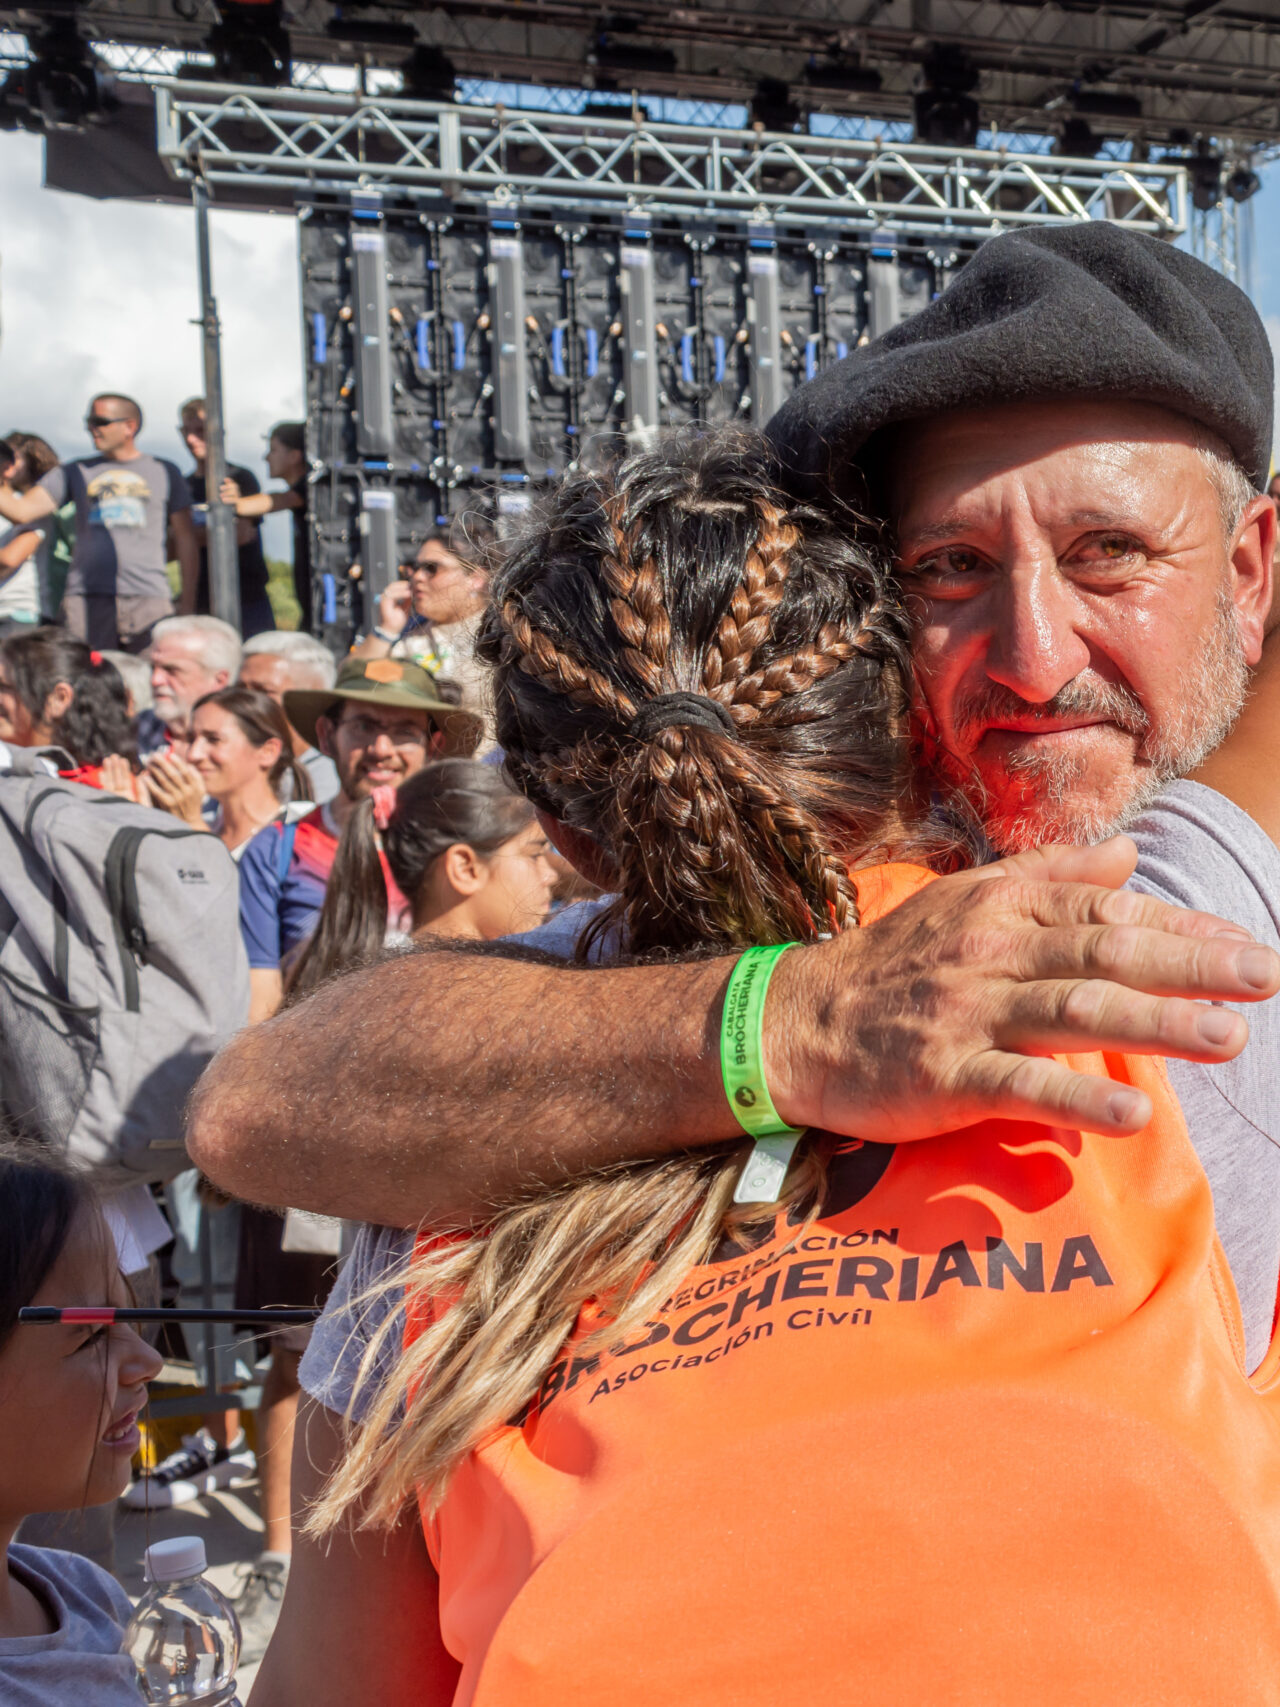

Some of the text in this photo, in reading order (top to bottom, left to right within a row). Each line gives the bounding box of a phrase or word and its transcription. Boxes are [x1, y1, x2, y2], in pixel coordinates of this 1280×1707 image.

[726, 980, 742, 1038] CABALGATA
[735, 961, 760, 1065] BROCHERIANA
[588, 1320, 773, 1405] Asociación
